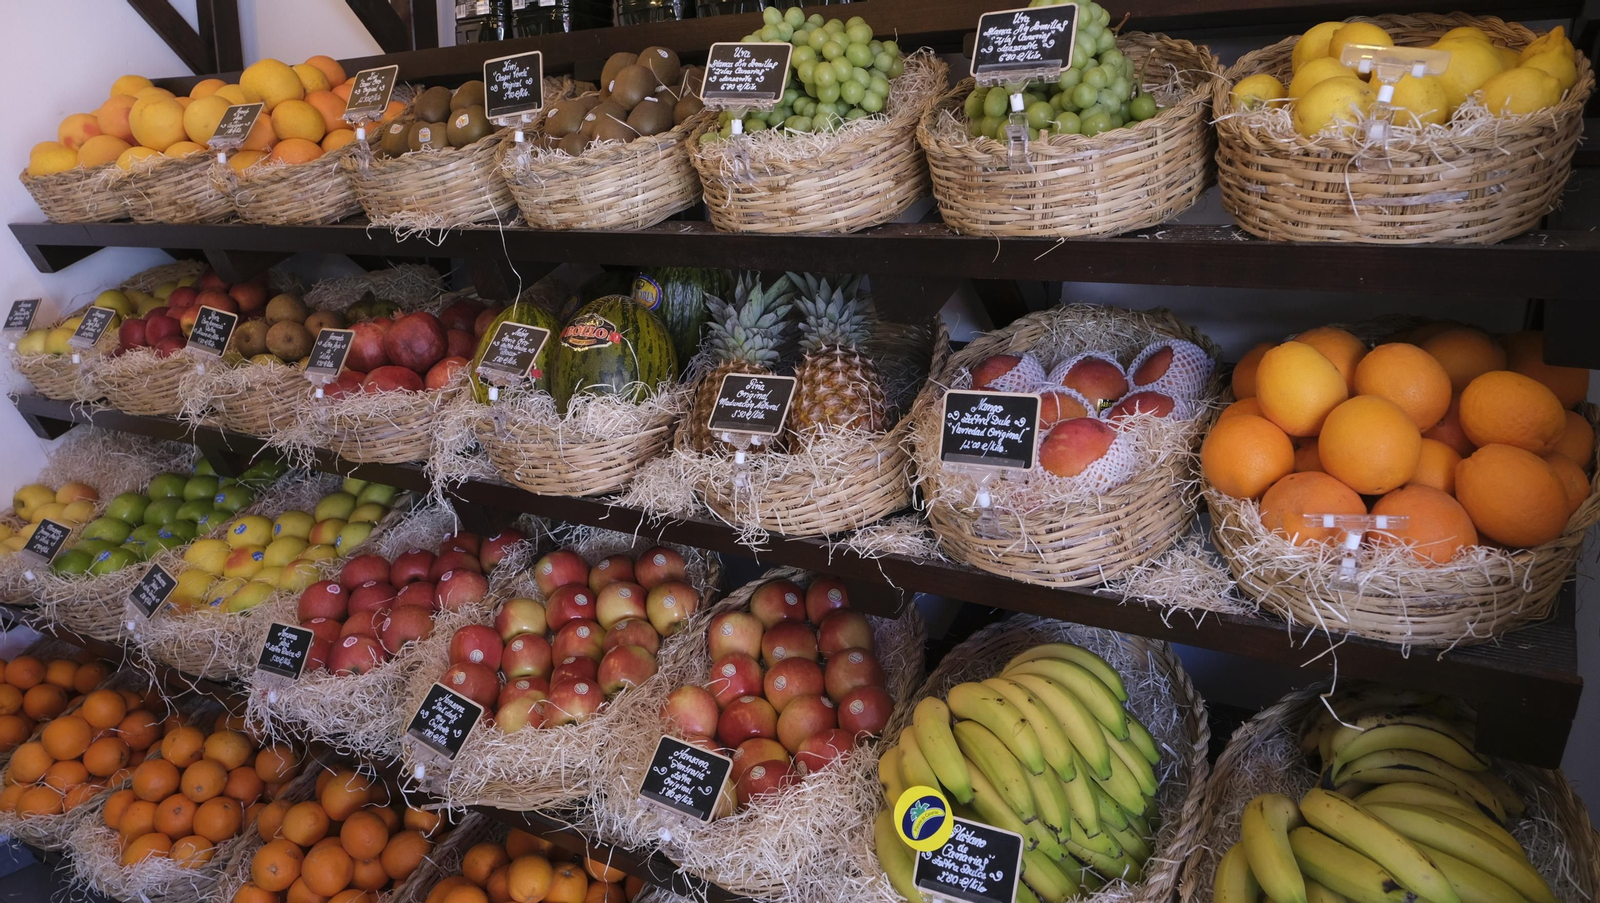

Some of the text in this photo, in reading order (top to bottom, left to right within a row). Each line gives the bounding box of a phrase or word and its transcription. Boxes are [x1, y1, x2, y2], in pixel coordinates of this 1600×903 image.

[565, 325, 608, 339] BOLLO
[736, 389, 773, 401] Original
[970, 397, 1004, 413] Mango
[663, 777, 696, 795] Original
[957, 844, 969, 854] de
[959, 863, 987, 880] Dulce
